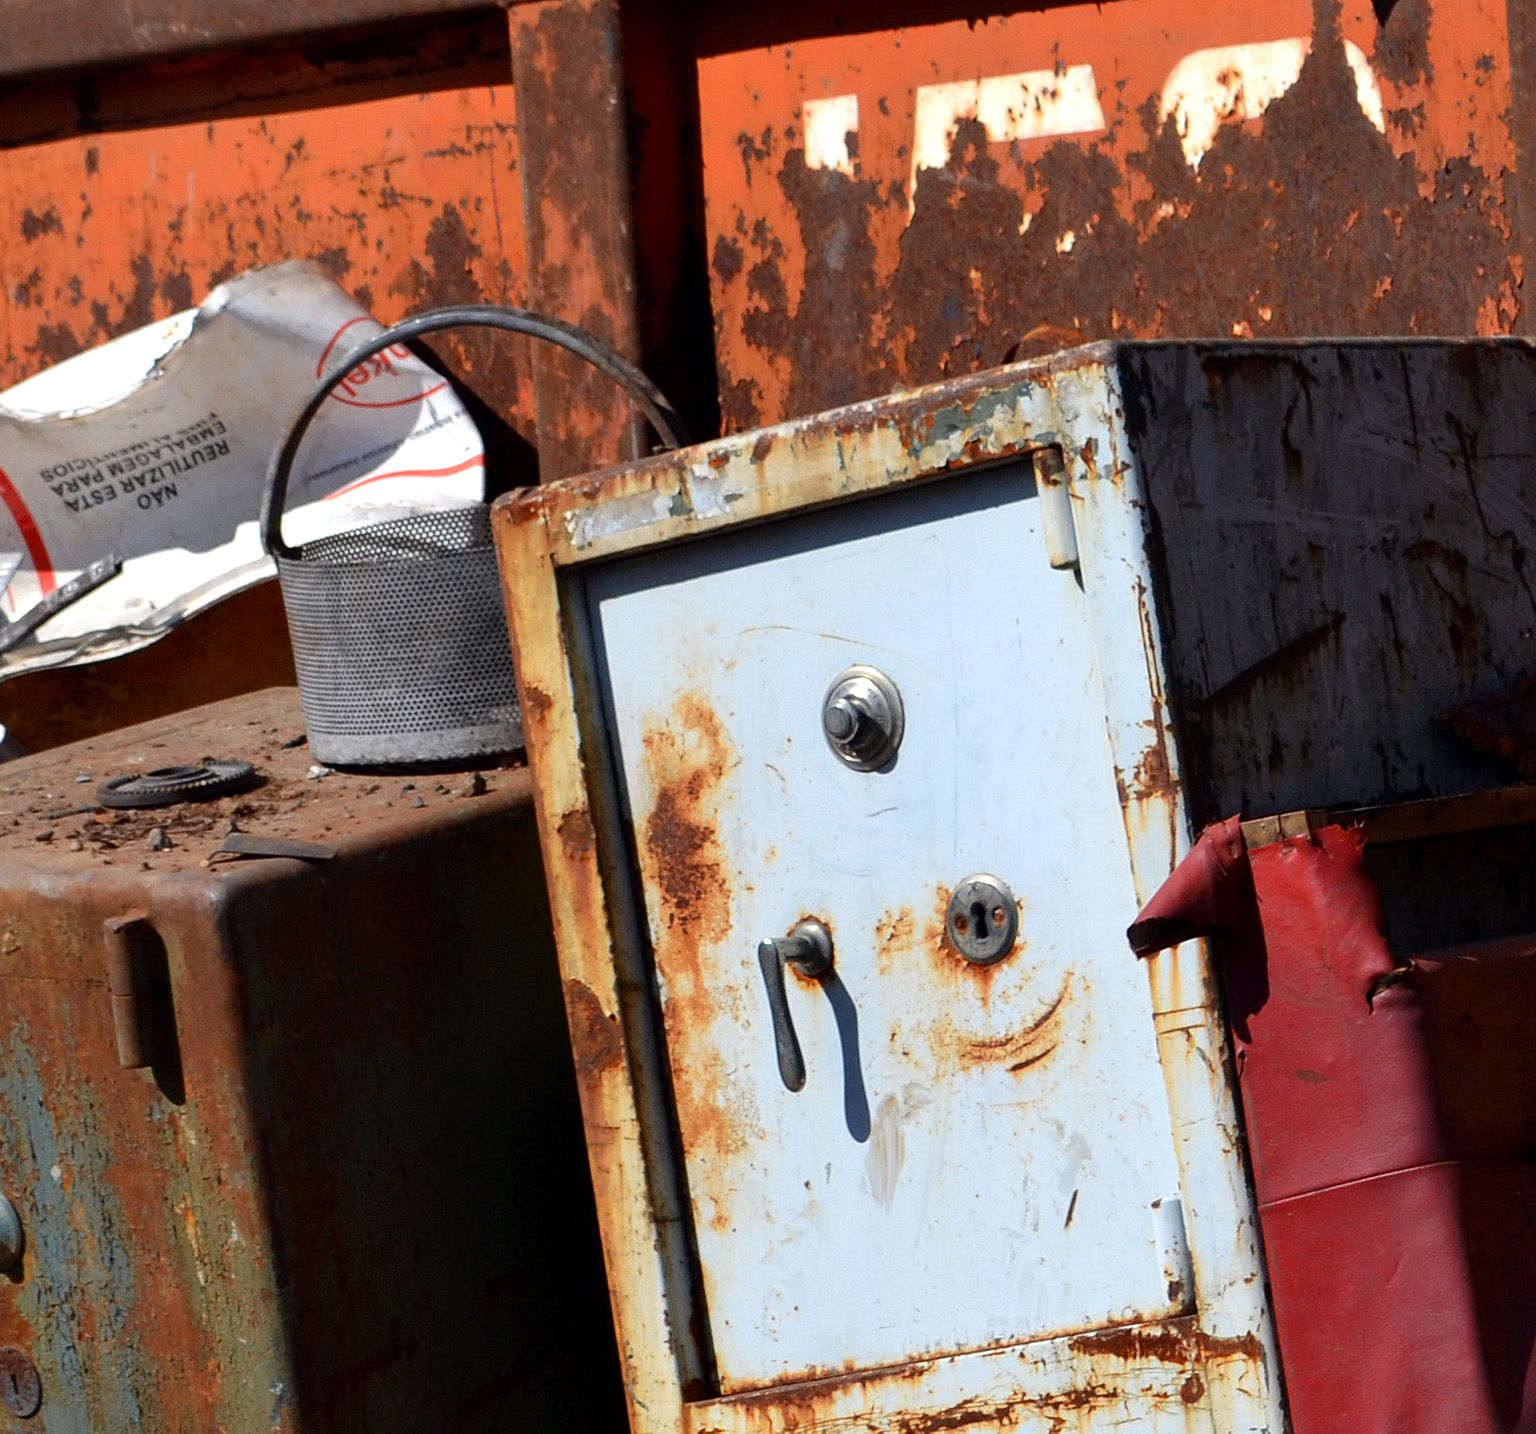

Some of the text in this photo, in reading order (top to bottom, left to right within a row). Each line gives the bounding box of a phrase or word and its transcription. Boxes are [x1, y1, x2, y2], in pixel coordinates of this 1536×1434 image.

[49, 419, 228, 497] EMBALAGEM PARA
[64, 439, 231, 513] REUTILIZAR ESTA
[136, 482, 179, 510] NÃO
